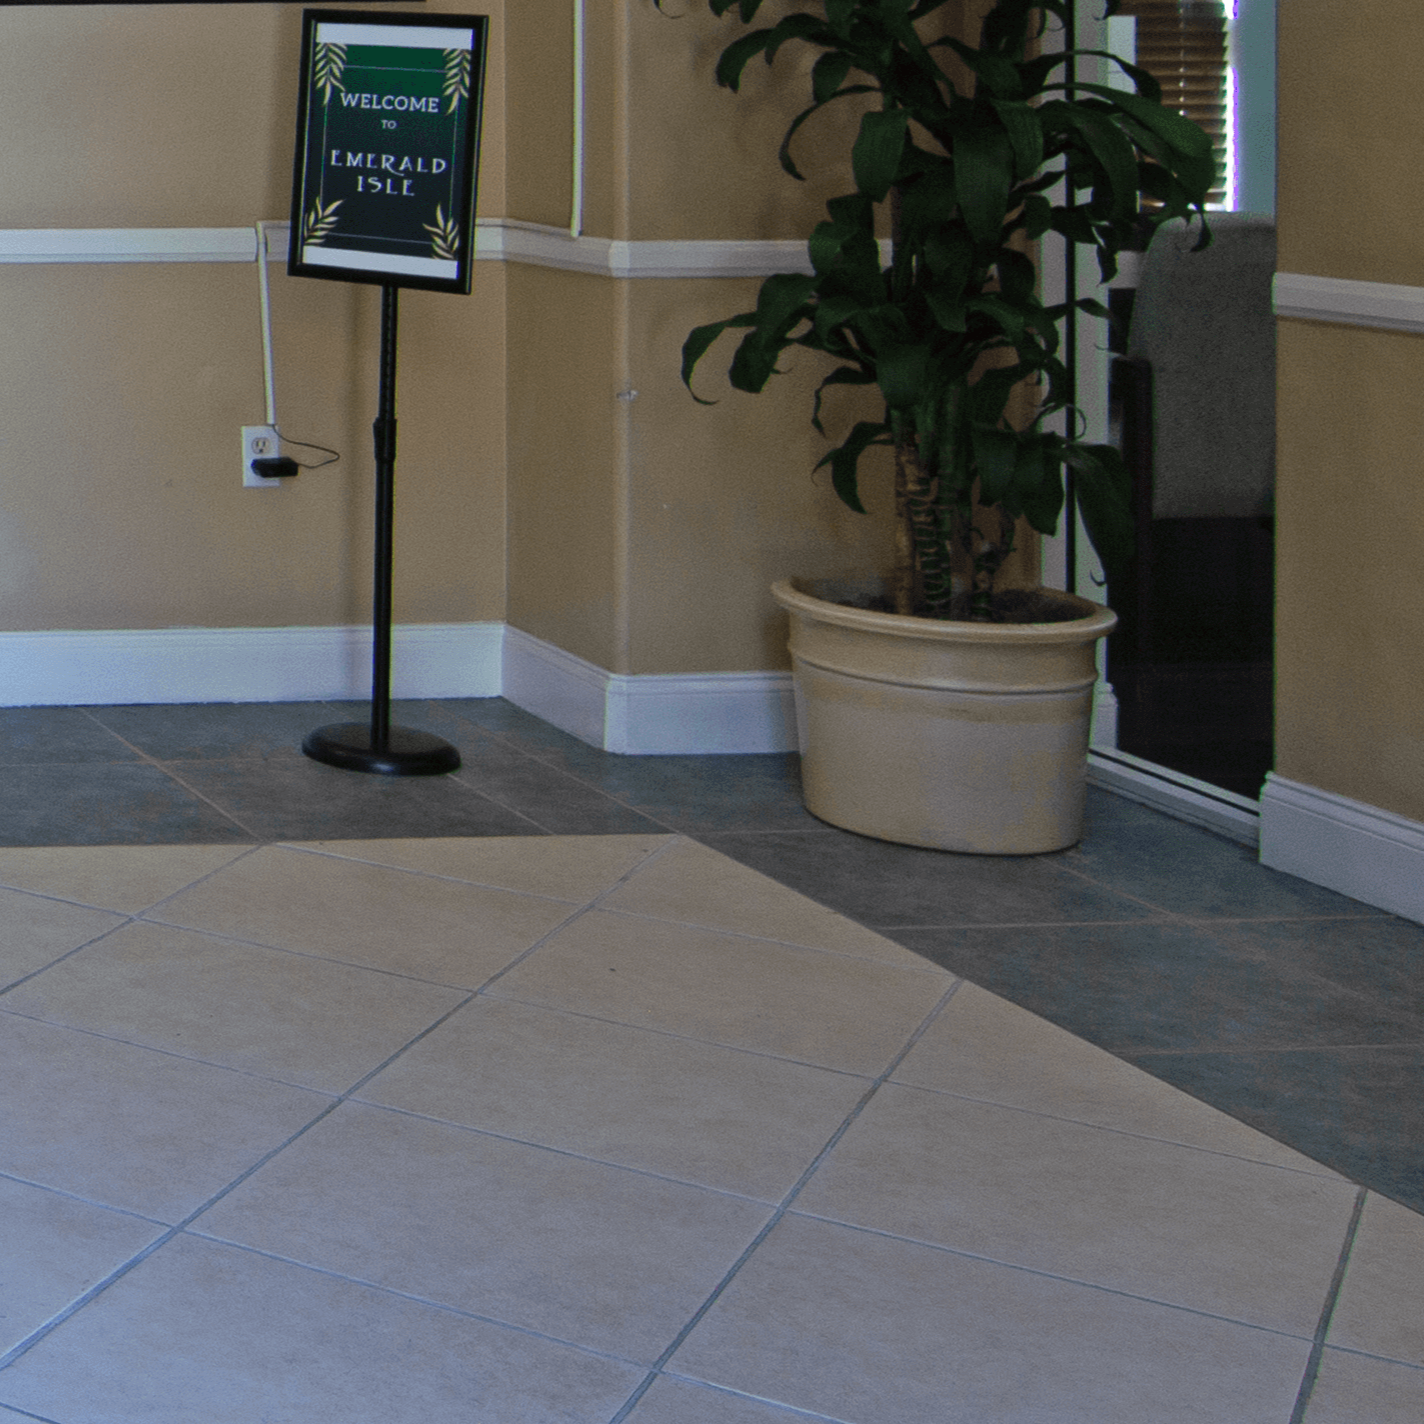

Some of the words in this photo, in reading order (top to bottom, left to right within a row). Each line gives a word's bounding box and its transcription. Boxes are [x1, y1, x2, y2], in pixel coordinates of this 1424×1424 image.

[340, 92, 440, 113] WELCOME
[380, 119, 397, 129] TO
[331, 149, 448, 177] EMERALD
[357, 175, 415, 196] ISLE
